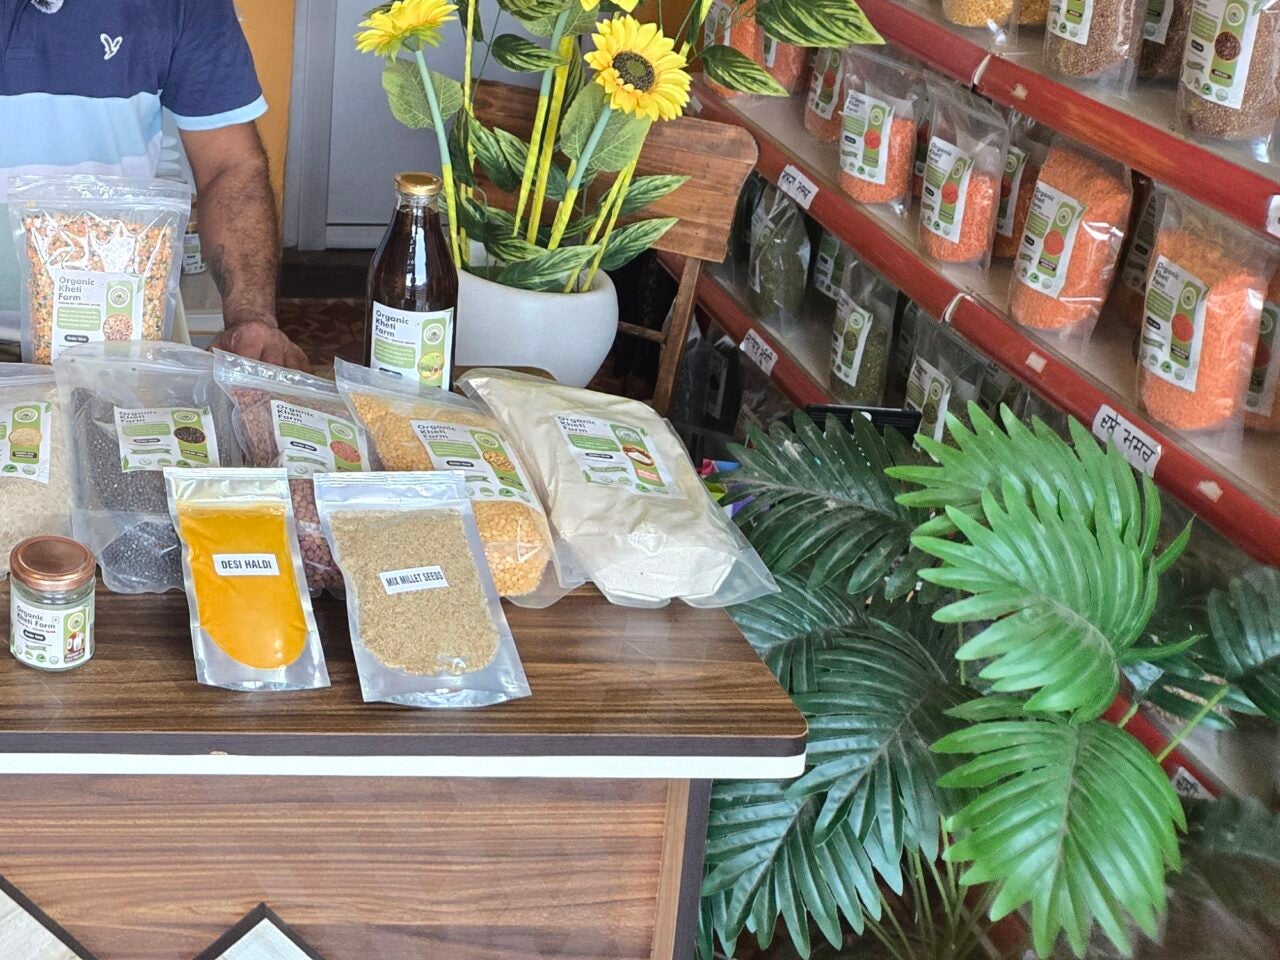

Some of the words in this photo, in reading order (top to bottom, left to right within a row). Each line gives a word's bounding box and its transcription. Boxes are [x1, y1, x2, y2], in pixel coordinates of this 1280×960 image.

[929, 149, 943, 159] Kheti
[931, 143, 953, 157] Organic
[927, 155, 939, 164] Farm
[1155, 270, 1170, 282] Kheti
[1157, 262, 1180, 280] Organic
[58, 276, 95, 286] Organic
[1154, 280, 1166, 290] Farm
[58, 285, 82, 293] Kheti
[58, 293, 81, 301] Farm
[375, 309, 410, 326] Organic
[375, 317, 397, 331] Kheti
[375, 325, 396, 338] Farm
[276, 404, 315, 418] Organic
[277, 409, 302, 419] Kheti
[278, 415, 303, 423] Farm
[557, 415, 597, 426] Organic
[1123, 428, 1157, 463] ਮਸਰ
[221, 560, 243, 570] DESI
[245, 560, 273, 570] HALDI
[385, 576, 401, 587] MIX
[400, 573, 423, 585] MILLET
[422, 571, 444, 582] SEEDS
[17, 605, 44, 622] Organic
[17, 613, 33, 626] Kheti
[35, 621, 56, 629] Farm
